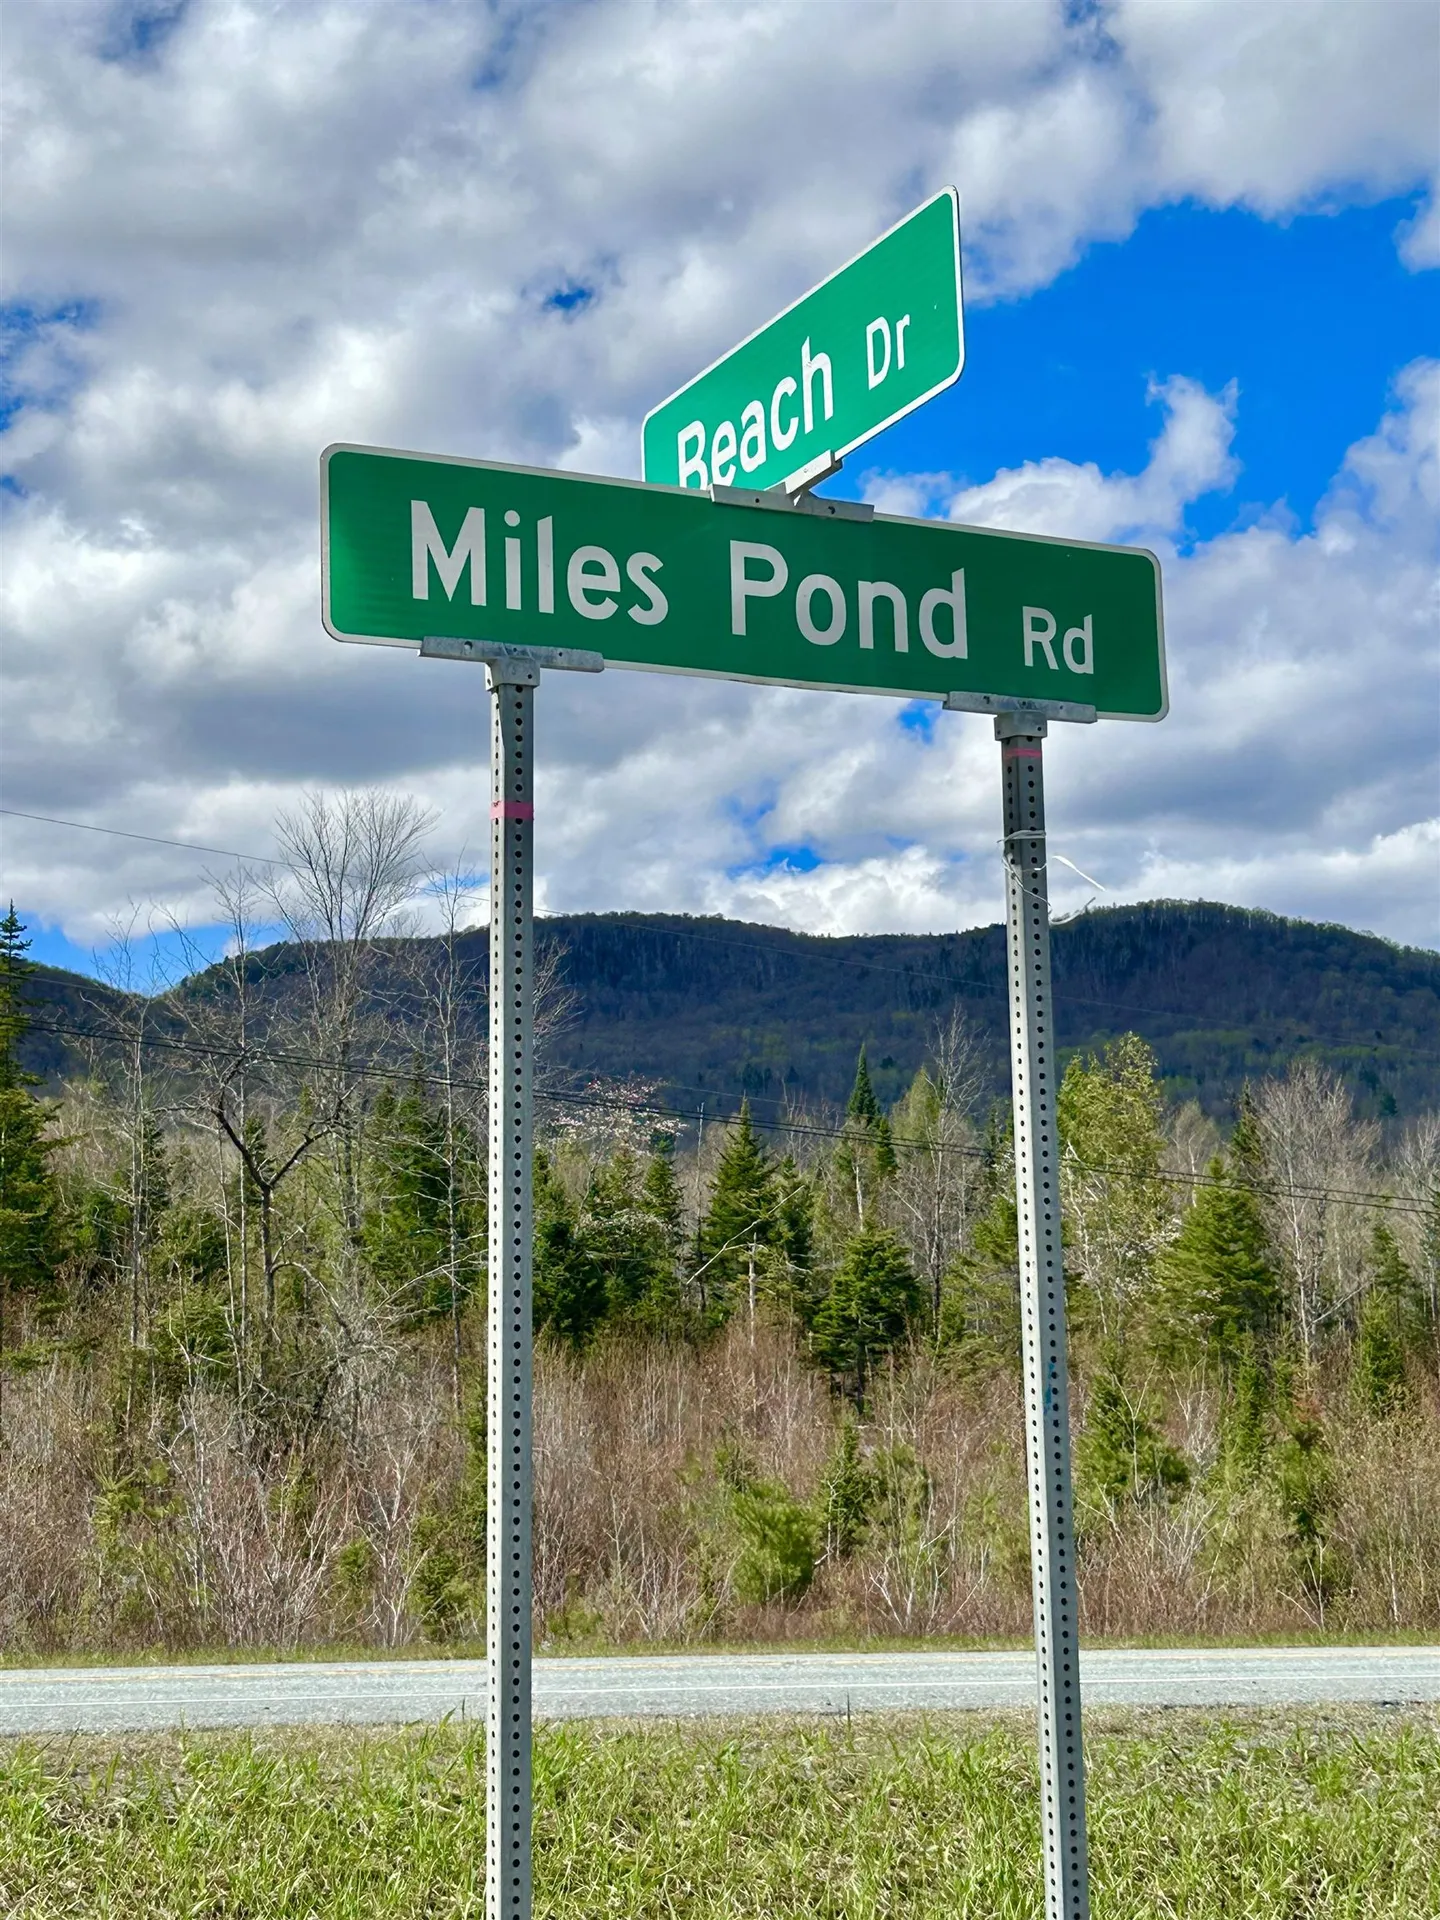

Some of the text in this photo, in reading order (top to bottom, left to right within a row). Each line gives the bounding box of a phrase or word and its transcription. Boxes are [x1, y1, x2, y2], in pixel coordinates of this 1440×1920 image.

[677, 314, 911, 491] Beach Dr
[410, 500, 1094, 675] Miles Pond Rd
